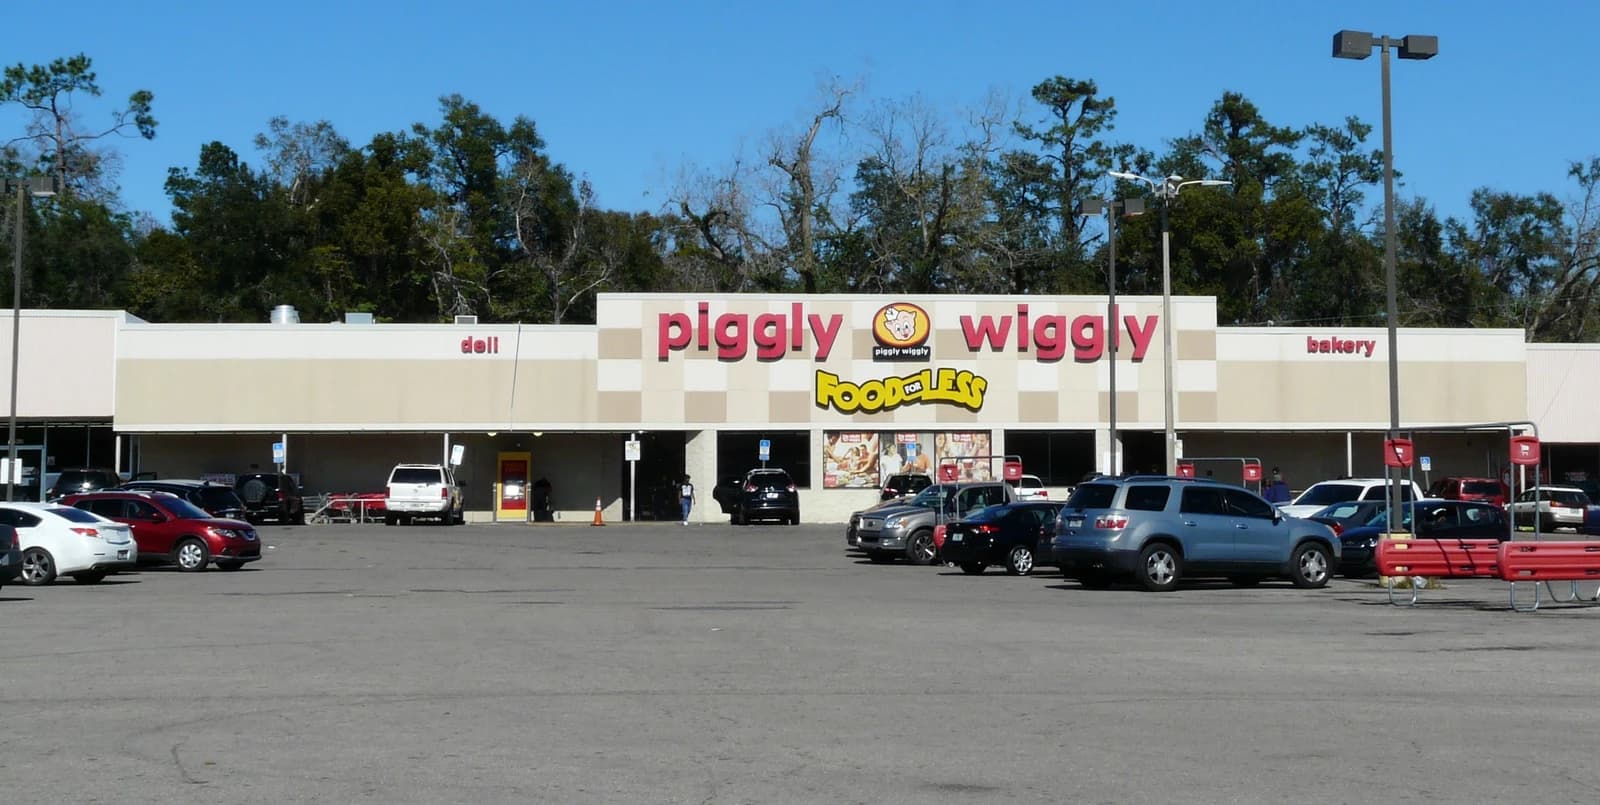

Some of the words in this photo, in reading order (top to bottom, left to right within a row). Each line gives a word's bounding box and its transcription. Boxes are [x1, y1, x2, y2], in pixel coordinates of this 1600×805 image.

[658, 302, 843, 362] piggly
[960, 303, 1159, 363] wiggly
[461, 336, 498, 354] deli
[875, 347, 900, 356] piggly
[902, 347, 928, 356] wiggly
[1307, 336, 1376, 357] bakery
[816, 370, 902, 415] FOOD
[904, 381, 922, 396] FOR
[920, 368, 988, 412] LESS
